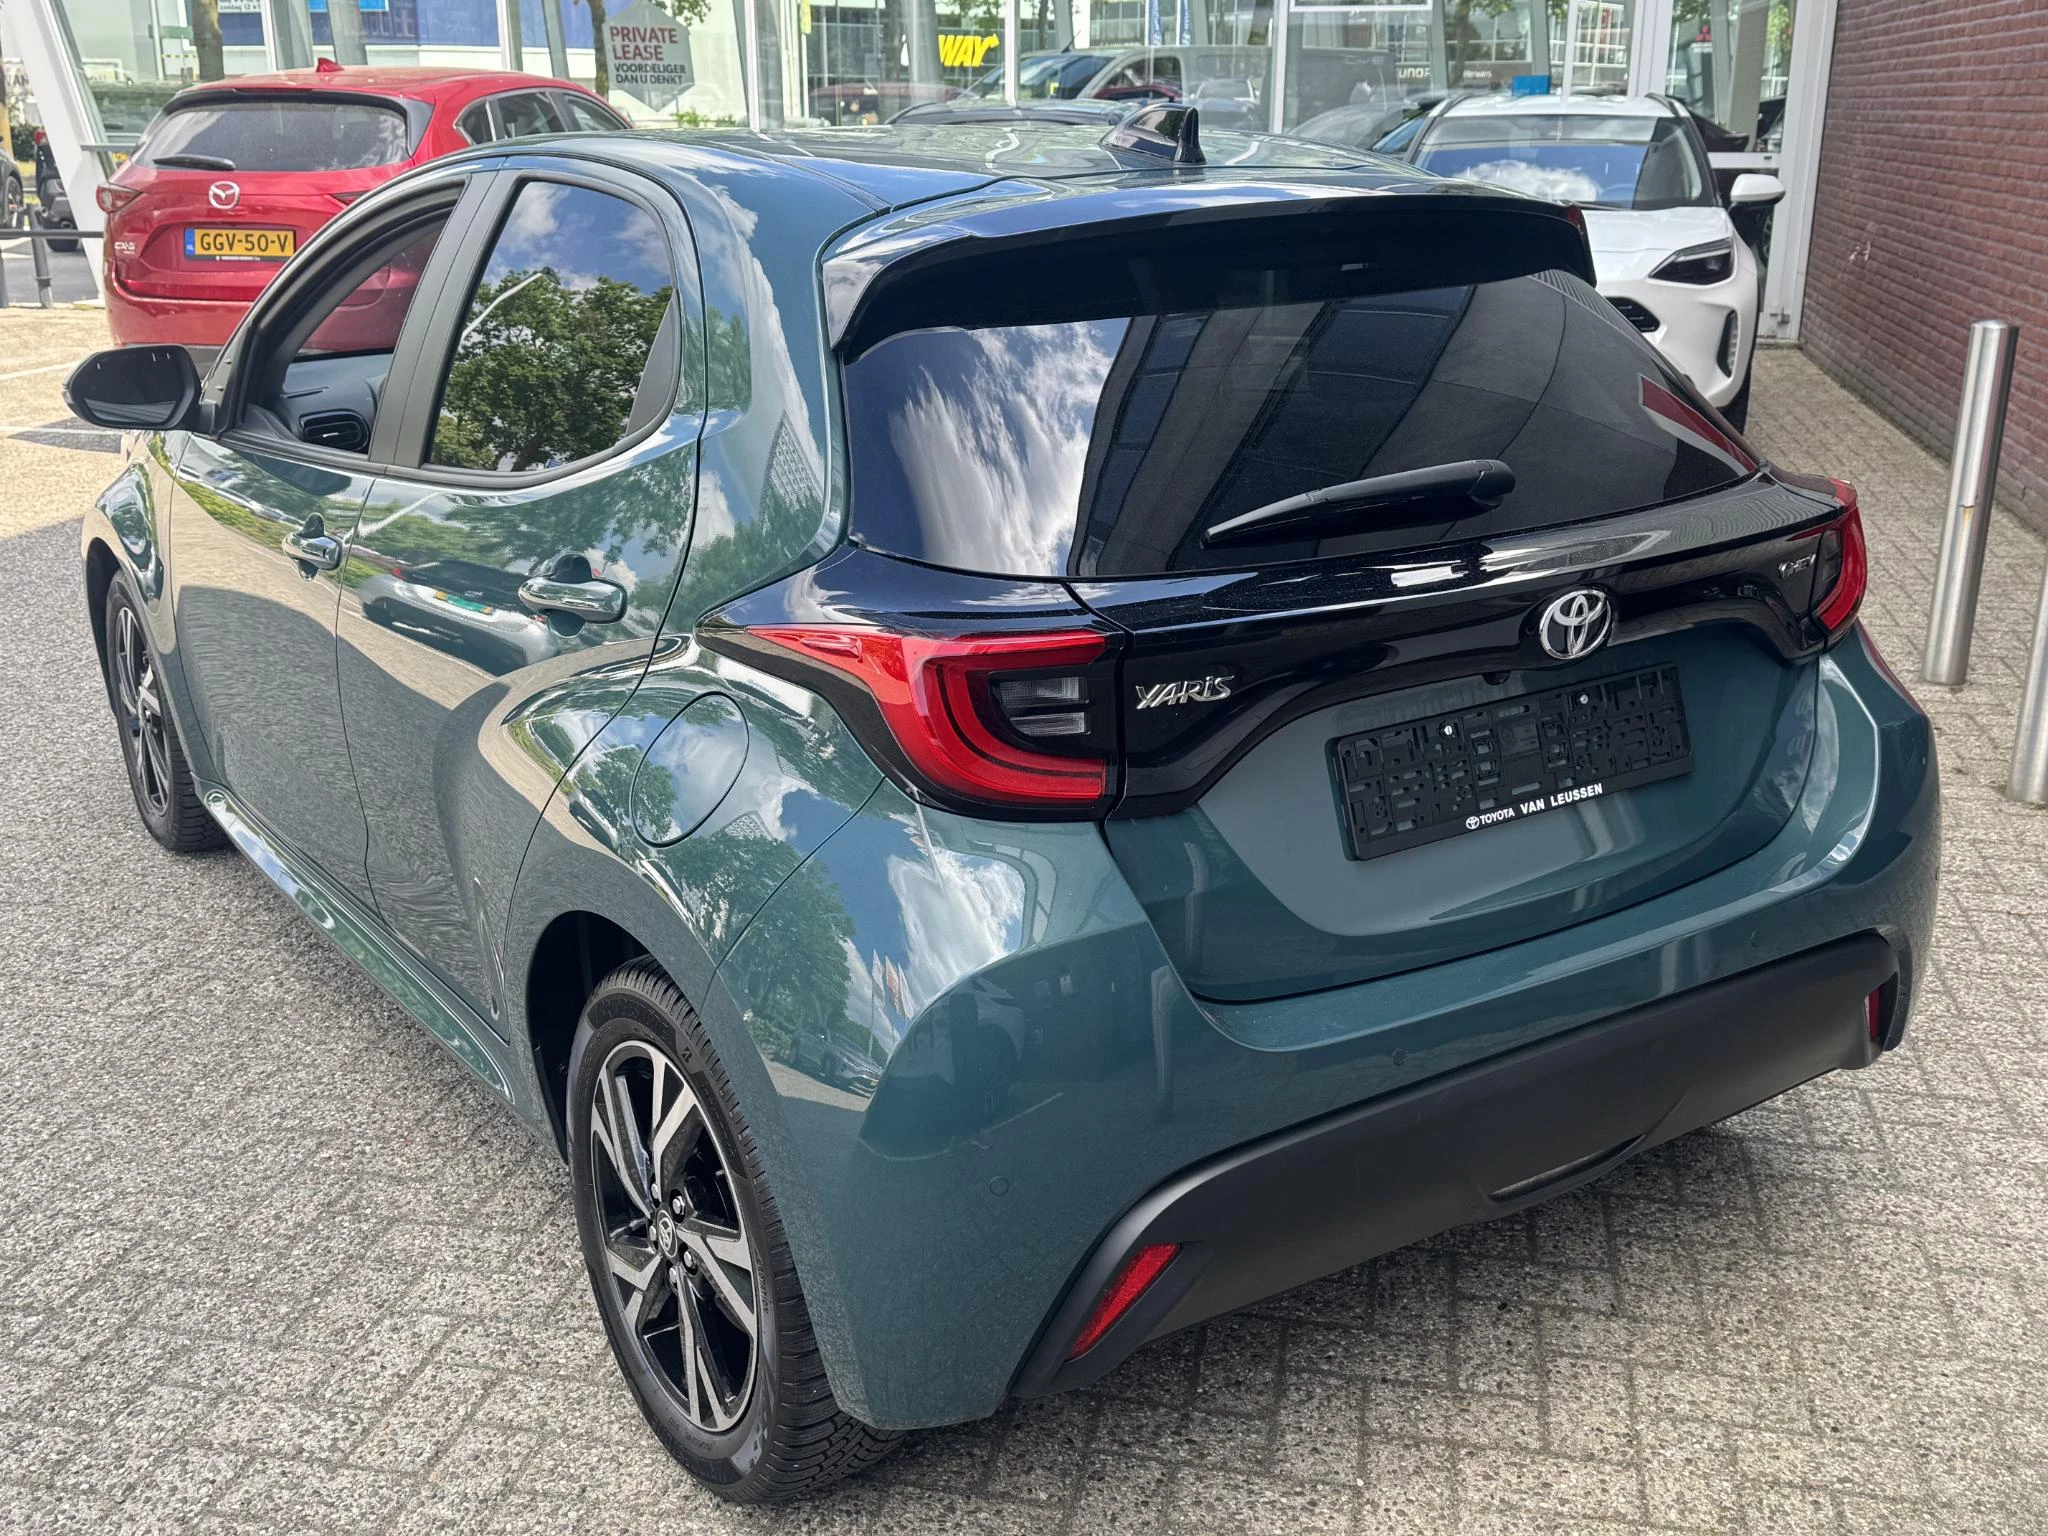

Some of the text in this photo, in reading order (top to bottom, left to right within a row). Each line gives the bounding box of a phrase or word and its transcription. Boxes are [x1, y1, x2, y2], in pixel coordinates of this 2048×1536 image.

[609, 26, 679, 44] PRIVATE
[612, 44, 665, 61] LEASE
[938, 33, 999, 67] WAY
[614, 63, 686, 74] VOORDELIGER
[615, 73, 684, 85] DAN U DENKT
[200, 233, 288, 253] GGV-50-V
[1479, 783, 1603, 825] TOYOTA VAN LEUSSEN
